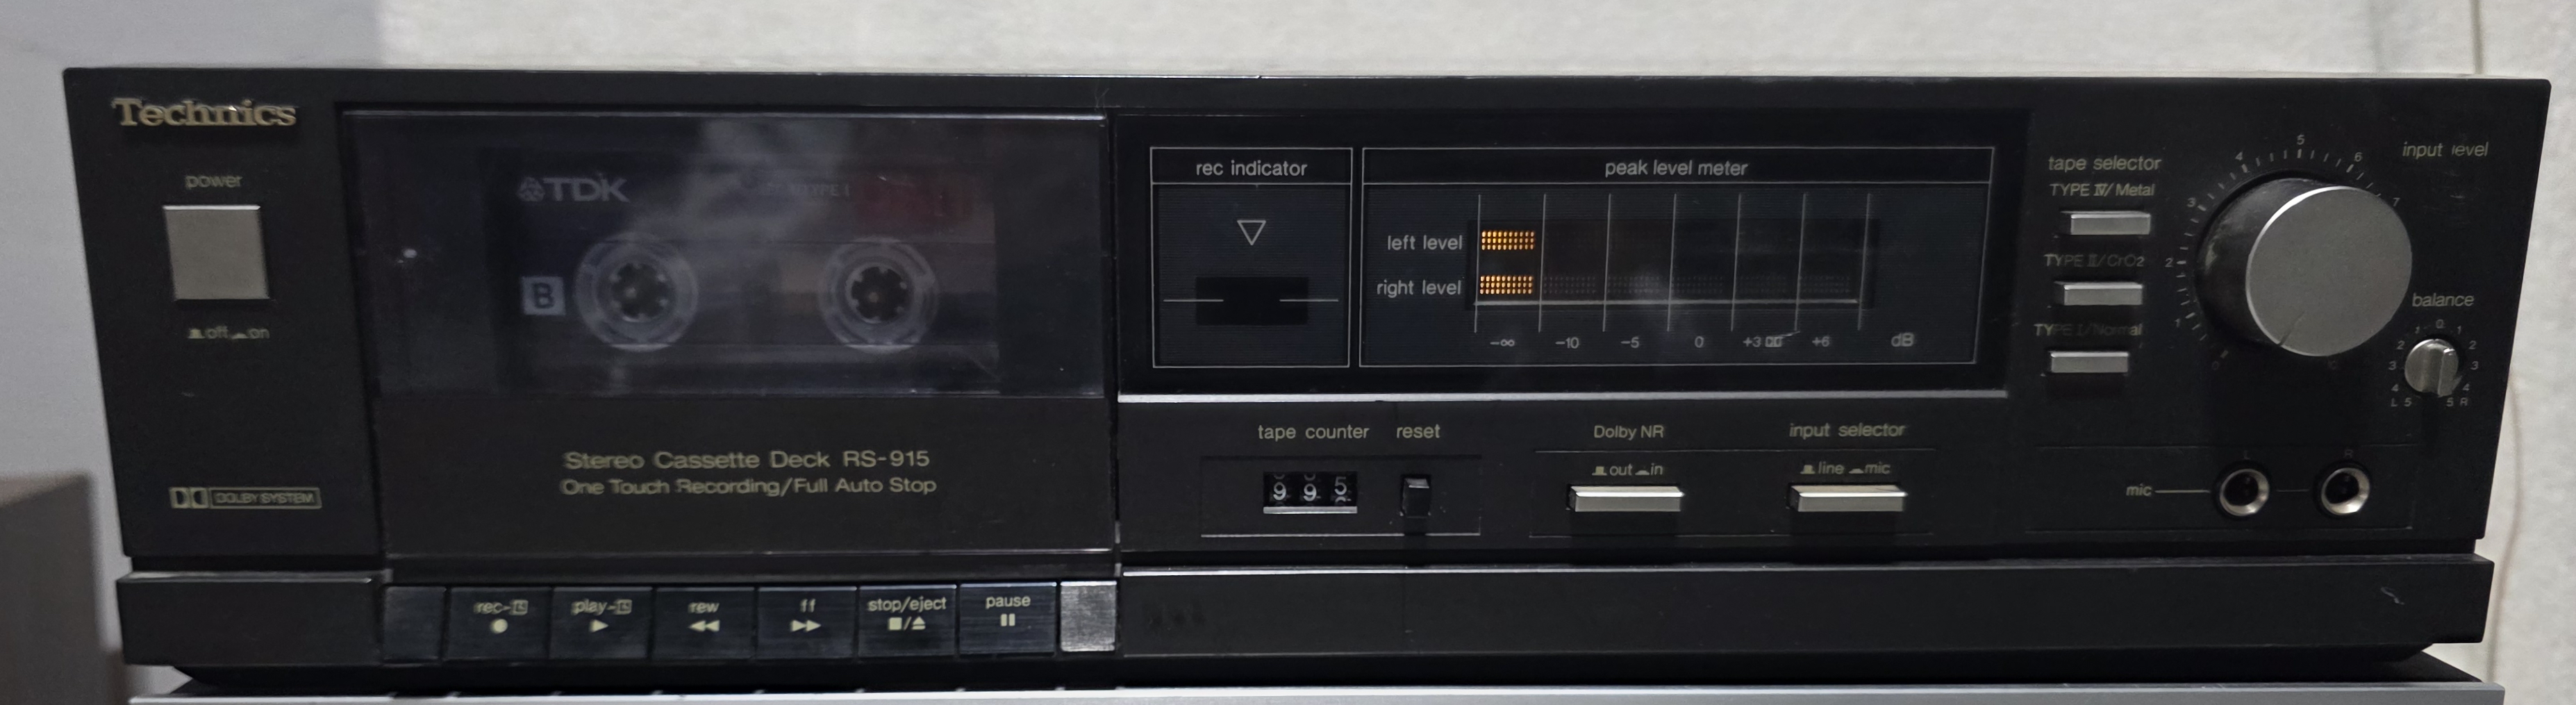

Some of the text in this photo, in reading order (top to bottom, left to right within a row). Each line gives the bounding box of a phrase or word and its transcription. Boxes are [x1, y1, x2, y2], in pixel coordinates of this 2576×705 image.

[111, 97, 297, 127] Technics
[2297, 134, 2305, 144] 5
[2235, 151, 2243, 160] 4
[2402, 141, 2488, 158] input level
[2354, 151, 2363, 162] 6
[1195, 158, 1307, 176] rec indicator
[1604, 158, 1749, 179] peak level meter
[2048, 155, 2161, 173] tape selector
[185, 174, 242, 188] power
[542, 176, 631, 203] TDK
[2050, 183, 2091, 197] TYPE
[2187, 198, 2195, 207] 3
[2393, 197, 2400, 208] 7
[1388, 235, 1463, 250] left level
[2043, 254, 2084, 267] TYPE
[2165, 257, 2174, 267] 2
[1376, 279, 1462, 299] right level
[533, 283, 554, 309] B
[2412, 292, 2475, 307] balance
[2175, 318, 2181, 327] 1
[206, 326, 228, 338] off
[248, 329, 269, 339] on
[2034, 323, 2072, 336] TYPE
[2415, 326, 2420, 334] 1
[2457, 325, 2462, 335] 1
[1555, 336, 1579, 349] -10
[1620, 336, 1640, 348] -5
[1695, 336, 1704, 348] 0
[1743, 336, 1761, 348] +3
[1812, 336, 1830, 347] +6
[1891, 333, 1914, 347] dB
[2397, 340, 2405, 350] 2
[2468, 340, 2477, 350] 2
[2388, 361, 2397, 370] 3
[2470, 361, 2479, 370] 3
[2391, 383, 2399, 392] 4
[2463, 383, 2470, 392] 4
[2391, 398, 2412, 407] L 5
[2446, 397, 2468, 407] 5 R
[1258, 424, 1370, 440] tape counter
[1396, 424, 1440, 438] reset
[1594, 425, 1663, 440] Dolby NR
[1789, 422, 1905, 438] input selector
[563, 450, 929, 469] Stereo Cassette Deck RS-915
[1609, 465, 1632, 476] out
[1650, 464, 1663, 475] in
[1818, 461, 1844, 474] line
[1864, 462, 1890, 474] mic
[560, 478, 604, 495] One
[610, 478, 670, 495] Touch
[835, 477, 883, 492] Auto
[889, 477, 937, 495] Stop
[2127, 483, 2151, 497] mic
[215, 492, 314, 504] DOLBY SYSTEM
[688, 602, 719, 613] rew
[800, 599, 815, 612] ff
[867, 596, 947, 613] stop/eject
[986, 595, 1031, 609] pause
